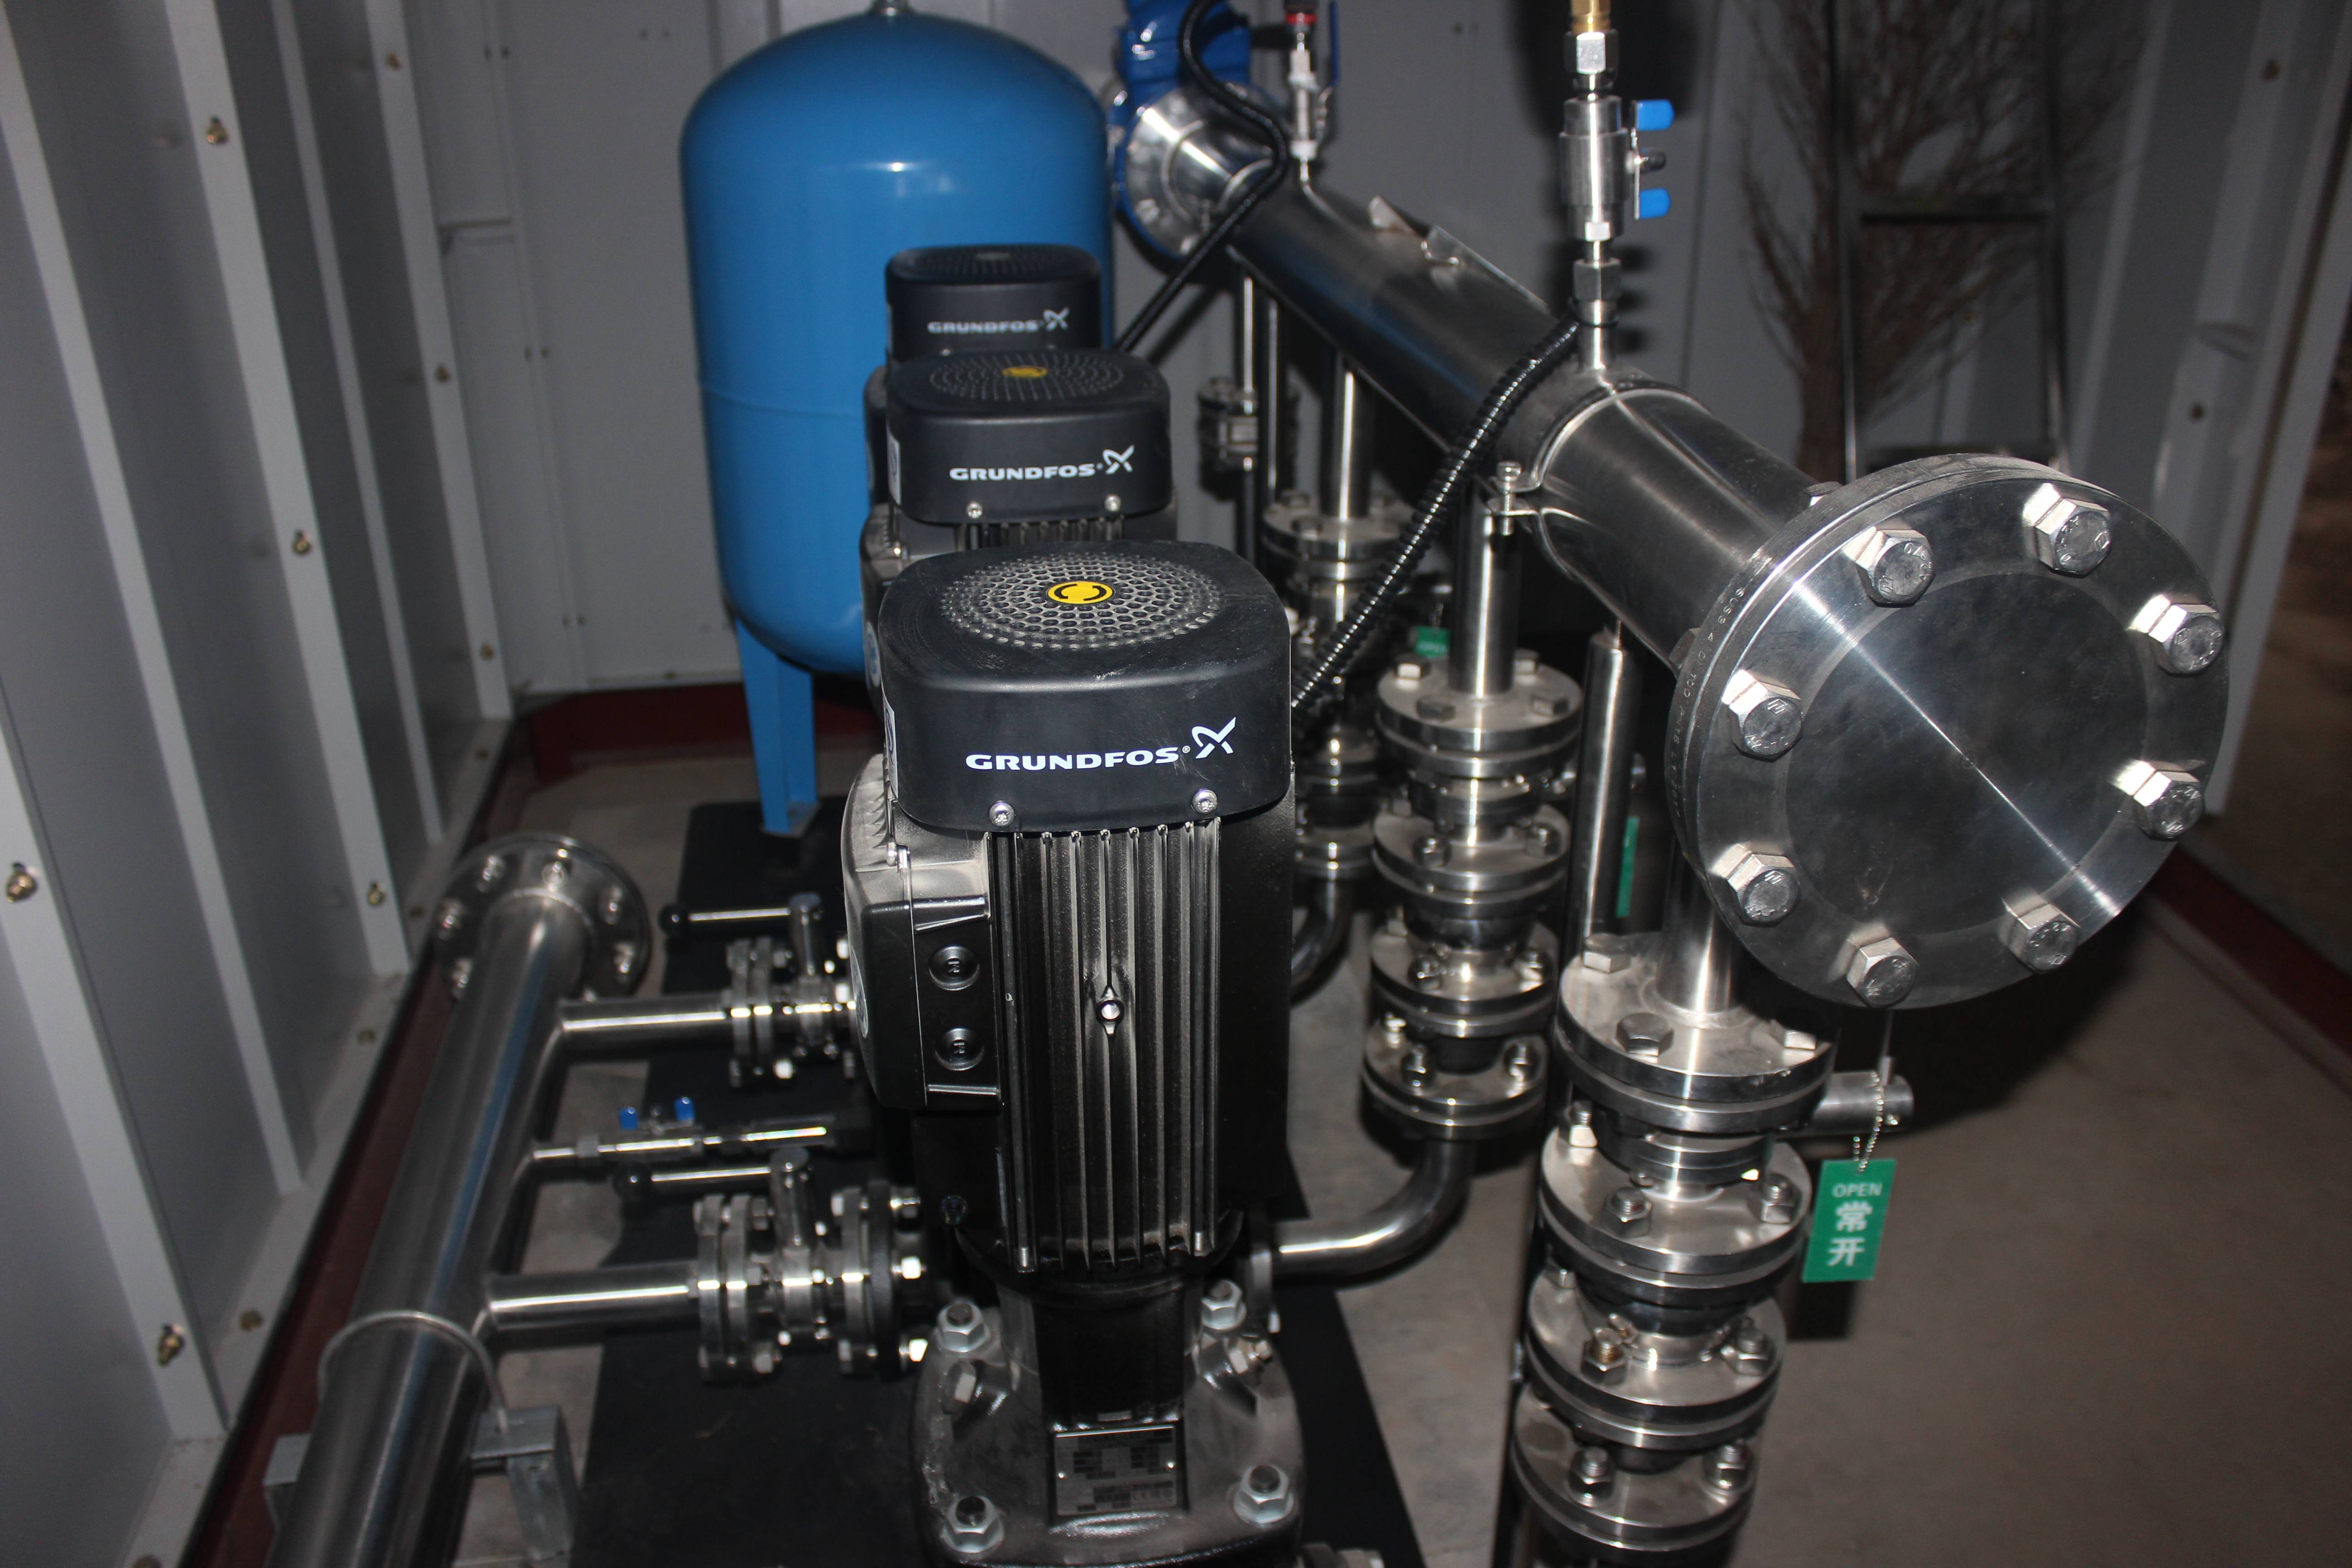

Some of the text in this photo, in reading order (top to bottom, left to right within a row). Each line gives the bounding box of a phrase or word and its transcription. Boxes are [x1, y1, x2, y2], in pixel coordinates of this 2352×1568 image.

[927, 320, 1039, 334] GRUNDFOS
[950, 463, 1095, 480] GRUNDFOS
[1833, 1183, 1883, 1198] OPEN
[1828, 1201, 1873, 1267] 常开
